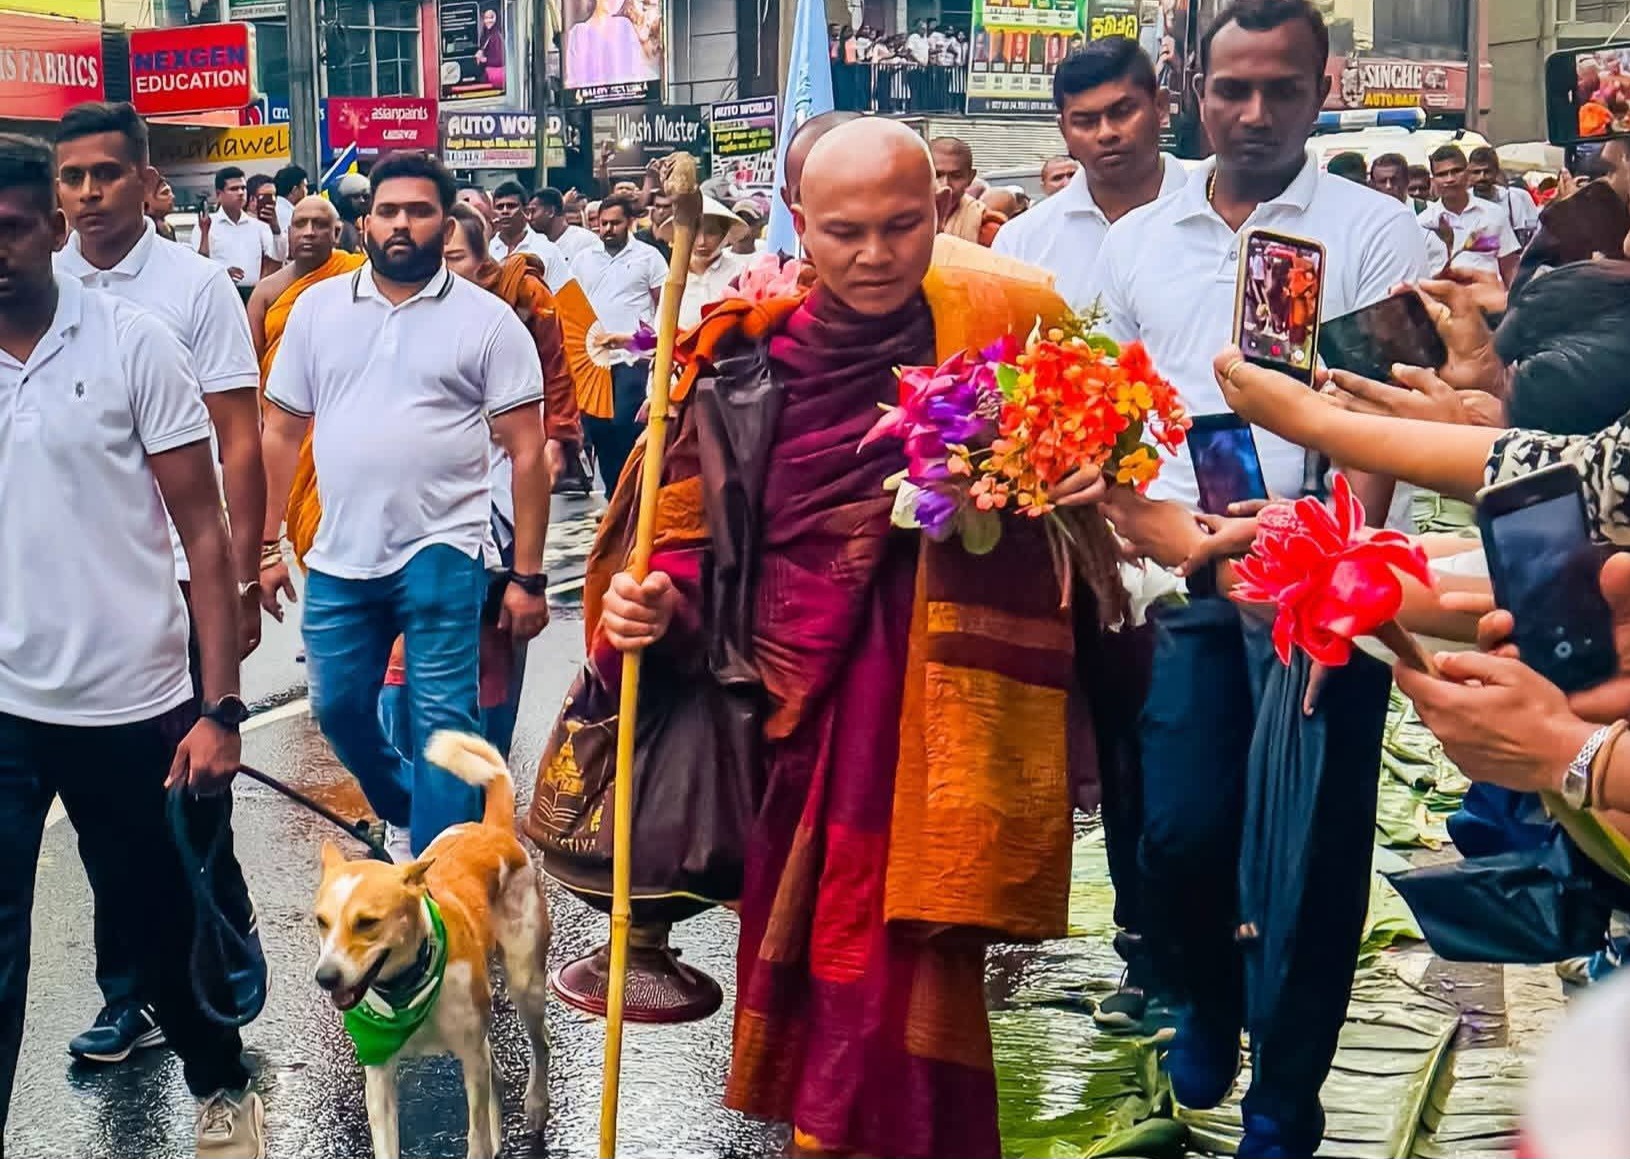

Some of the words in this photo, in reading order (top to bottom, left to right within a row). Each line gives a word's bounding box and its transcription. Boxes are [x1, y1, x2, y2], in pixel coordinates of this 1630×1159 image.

[20, 50, 98, 88] FABRICS
[136, 69, 247, 93] EDUCATION
[715, 104, 738, 119] AUTO
[448, 115, 496, 136] AUTO
[500, 115, 562, 135] WOD
[655, 113, 699, 143] Master
